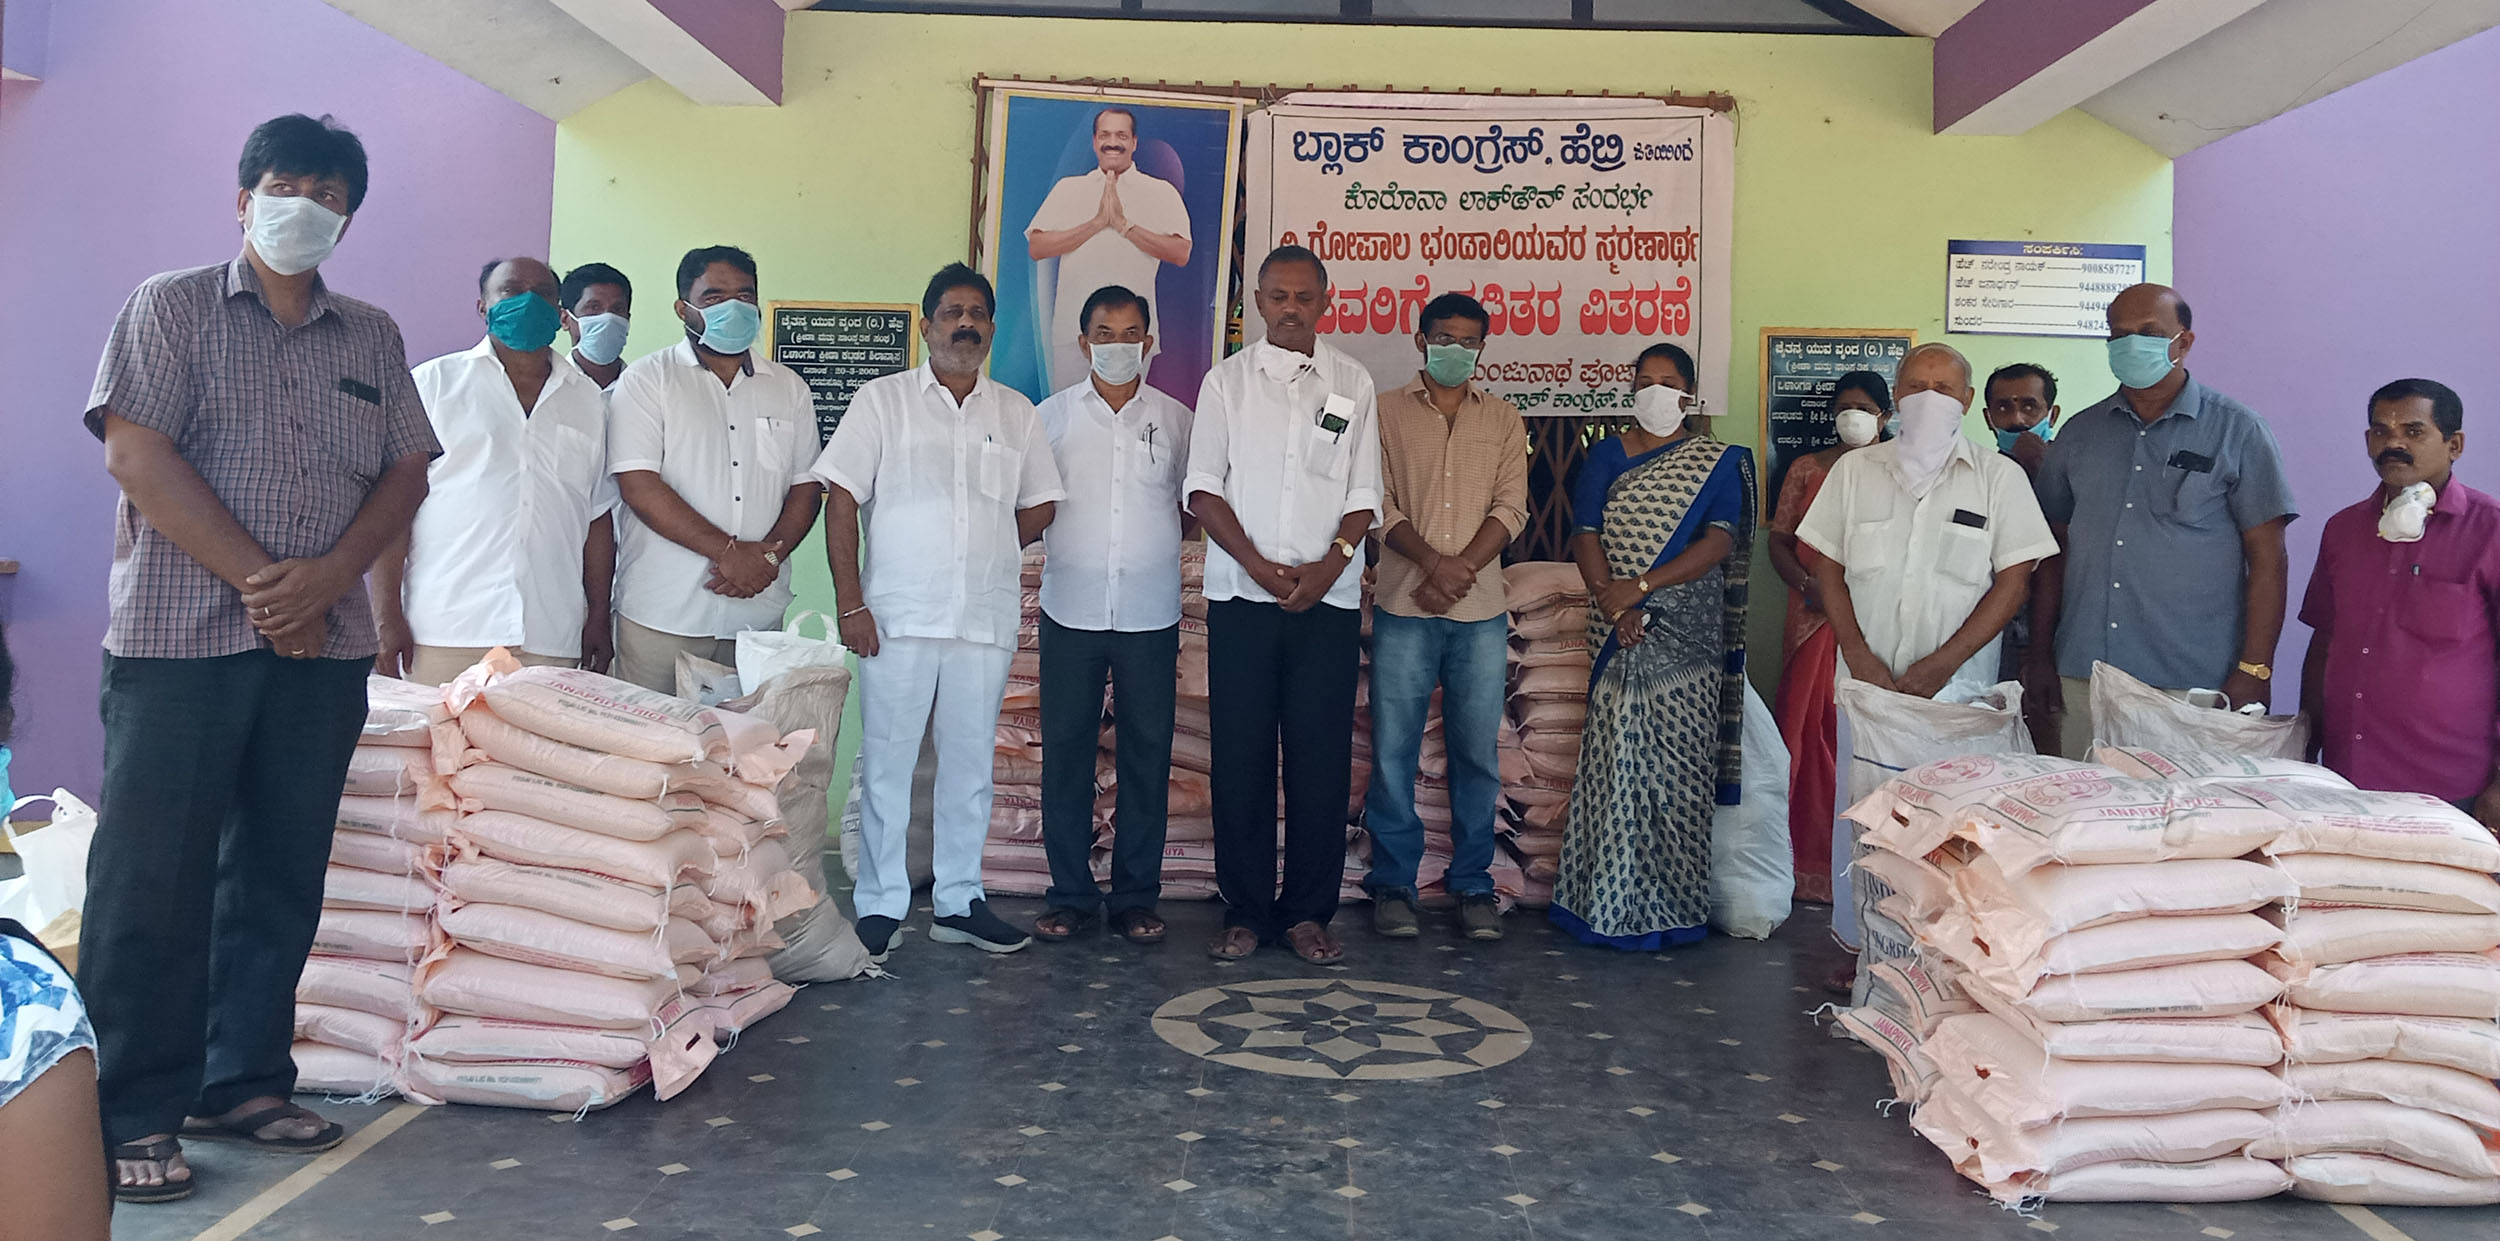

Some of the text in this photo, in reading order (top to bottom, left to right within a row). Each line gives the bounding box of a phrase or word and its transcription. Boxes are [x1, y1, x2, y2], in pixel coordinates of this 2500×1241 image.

[1293, 126, 1386, 176] ಬ್ಲಾಕ್
[1560, 122, 1627, 172] ಹೆಬ್ರಿ
[1571, 181, 1654, 216] ಸಂದರ್ಭ
[1420, 222, 1588, 266] ಭಂಡಾರಿಯವರ
[1594, 224, 1700, 276] ಸ್ಮರಣಾರ್ಥ
[2081, 262, 2137, 275] 9008587727
[2078, 282, 2134, 294] 94488882
[811, 316, 836, 327] ಯುವ
[1579, 275, 1693, 337] ವಿತರಣೆ
[1775, 341, 1803, 359] ಚೈತನ್ಯ
[1806, 342, 1832, 354] ಯುವ
[1835, 343, 1860, 360] ವೃಂದ
[1579, 358, 1638, 389] ಪೂಜಾ
[2066, 770, 2102, 783] RICE
[1873, 1017, 1914, 1053] JANAPRIYA
